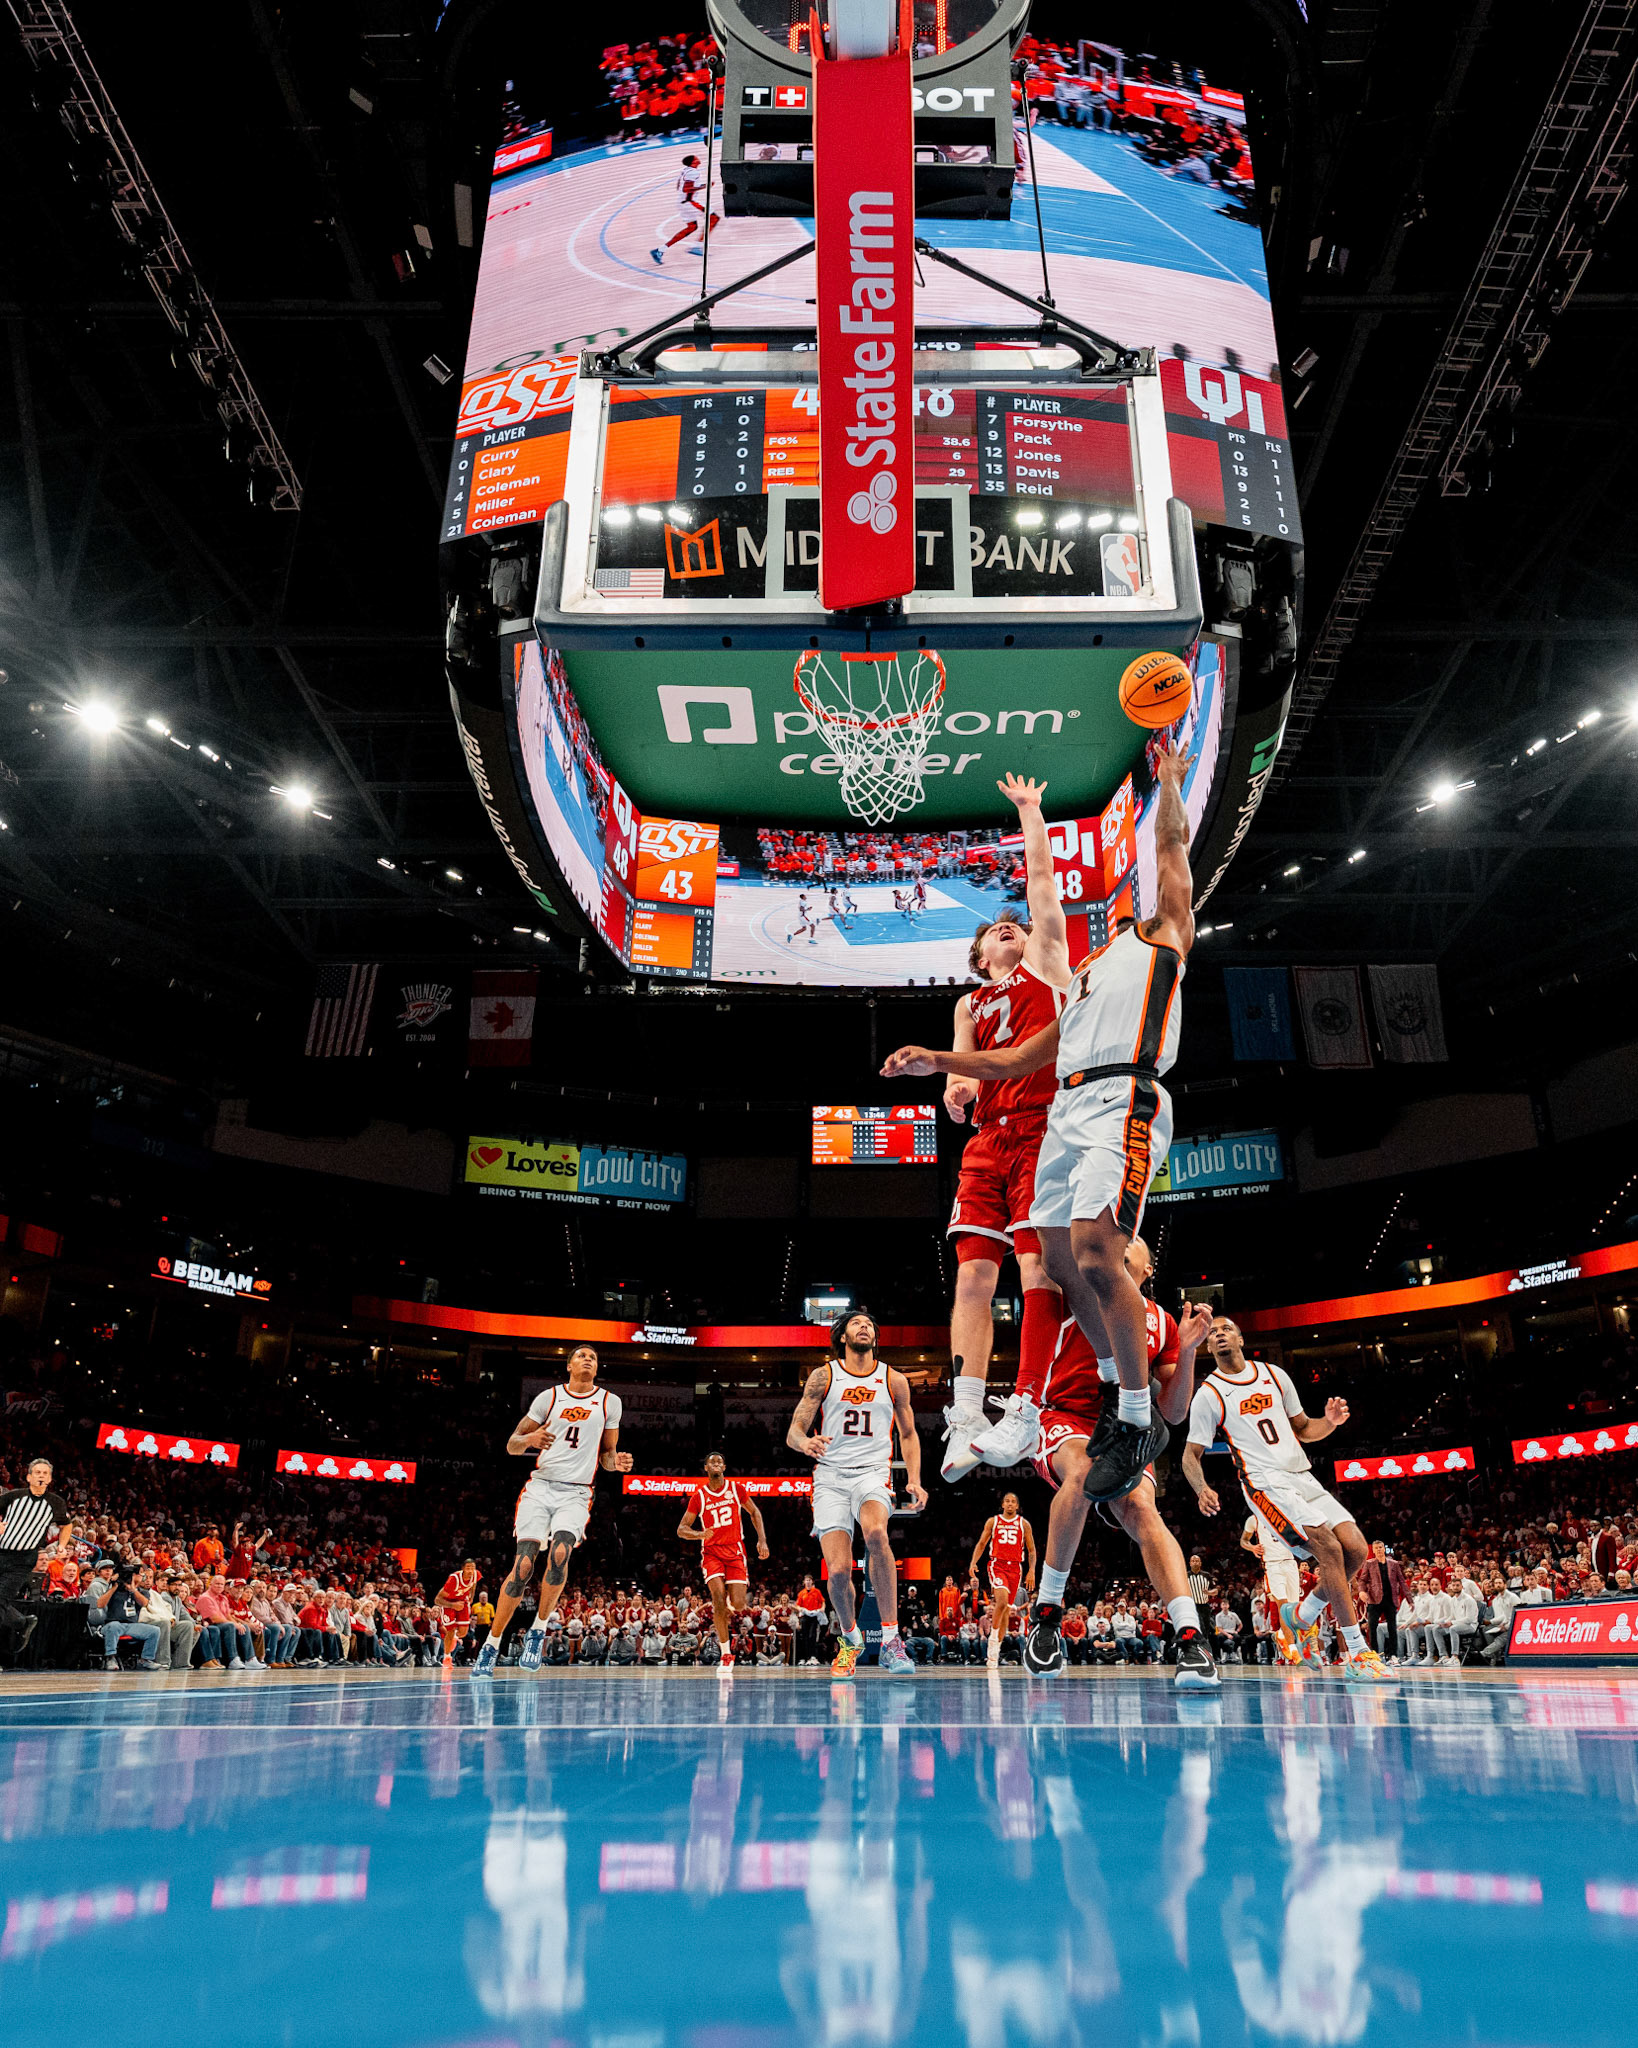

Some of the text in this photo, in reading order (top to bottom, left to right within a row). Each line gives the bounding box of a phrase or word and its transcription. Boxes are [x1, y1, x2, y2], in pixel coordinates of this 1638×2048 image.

[694, 396, 754, 409] PTS FLS
[792, 388, 820, 416] 4
[986, 396, 1061, 414] # PLAYER
[697, 415, 750, 429] 4 0
[987, 414, 1083, 432] 7 Forsythe
[460, 426, 526, 453] # PLAYER
[697, 432, 748, 444] 8 2
[769, 437, 798, 445] FG%
[942, 437, 971, 447] 38.6
[987, 430, 1052, 446] 9 Pack
[1228, 432, 1282, 454] PTS FLS
[458, 448, 519, 471] 0 Curry
[696, 448, 748, 461] 5 0
[768, 452, 787, 461] TO
[952, 452, 961, 460] 6
[985, 447, 1062, 463] 12 Jones
[1233, 451, 1278, 469] 0 1
[458, 465, 516, 486] 1 Clary
[695, 464, 745, 478] 7 1
[768, 467, 795, 476] REB
[948, 468, 966, 477] 29
[985, 463, 1060, 480] 13 Davis
[1232, 464, 1280, 485] 13 1
[453, 475, 540, 502] 4 Coleman
[693, 481, 747, 495] 0 0
[985, 480, 1005, 492] 35
[1016, 483, 1053, 496] Reid
[1237, 482, 1282, 501] 9 1
[452, 496, 516, 519] 5 Miller
[1240, 498, 1285, 518] 2 1
[447, 508, 537, 538] 21 Coleman
[1242, 515, 1289, 534] 5 0
[970, 526, 1075, 576] BANK
[1110, 585, 1128, 596] NBA
[1153, 672, 1185, 694] NCAA
[612, 840, 629, 880] 48
[1114, 838, 1128, 878] 43
[659, 870, 693, 900] 43
[400, 983, 453, 1003] THUNDER
[1076, 970, 1092, 1003] 1
[982, 995, 1014, 1044] 7
[834, 1109, 852, 1119] 43
[896, 1108, 915, 1119] 48
[1126, 1118, 1149, 1196] COWBOYS
[1174, 1145, 1225, 1184] LOUD
[1232, 1144, 1277, 1173] CITY
[583, 1158, 682, 1195] LOUD CITY
[479, 1186, 671, 1212] BRING THE THUNDER EXIT NOW
[1212, 1187, 1239, 1197] EXIT
[1242, 1184, 1270, 1194] NOW
[173, 1259, 253, 1292] BEDLAM
[1519, 1260, 1567, 1277] PRESENTED BY
[188, 1280, 236, 1297] BASKETBALL
[644, 1325, 678, 1334] PRESENTED
[840, 1386, 877, 1405] OSU
[1240, 1393, 1273, 1416] OSU
[559, 1407, 592, 1422] OSU
[843, 1409, 873, 1437] 21
[564, 1426, 580, 1449] 4
[1257, 1418, 1280, 1445] 0
[711, 1506, 732, 1528] 12
[1252, 1491, 1287, 1533] COWBOYS
[998, 1529, 1018, 1544] 35
